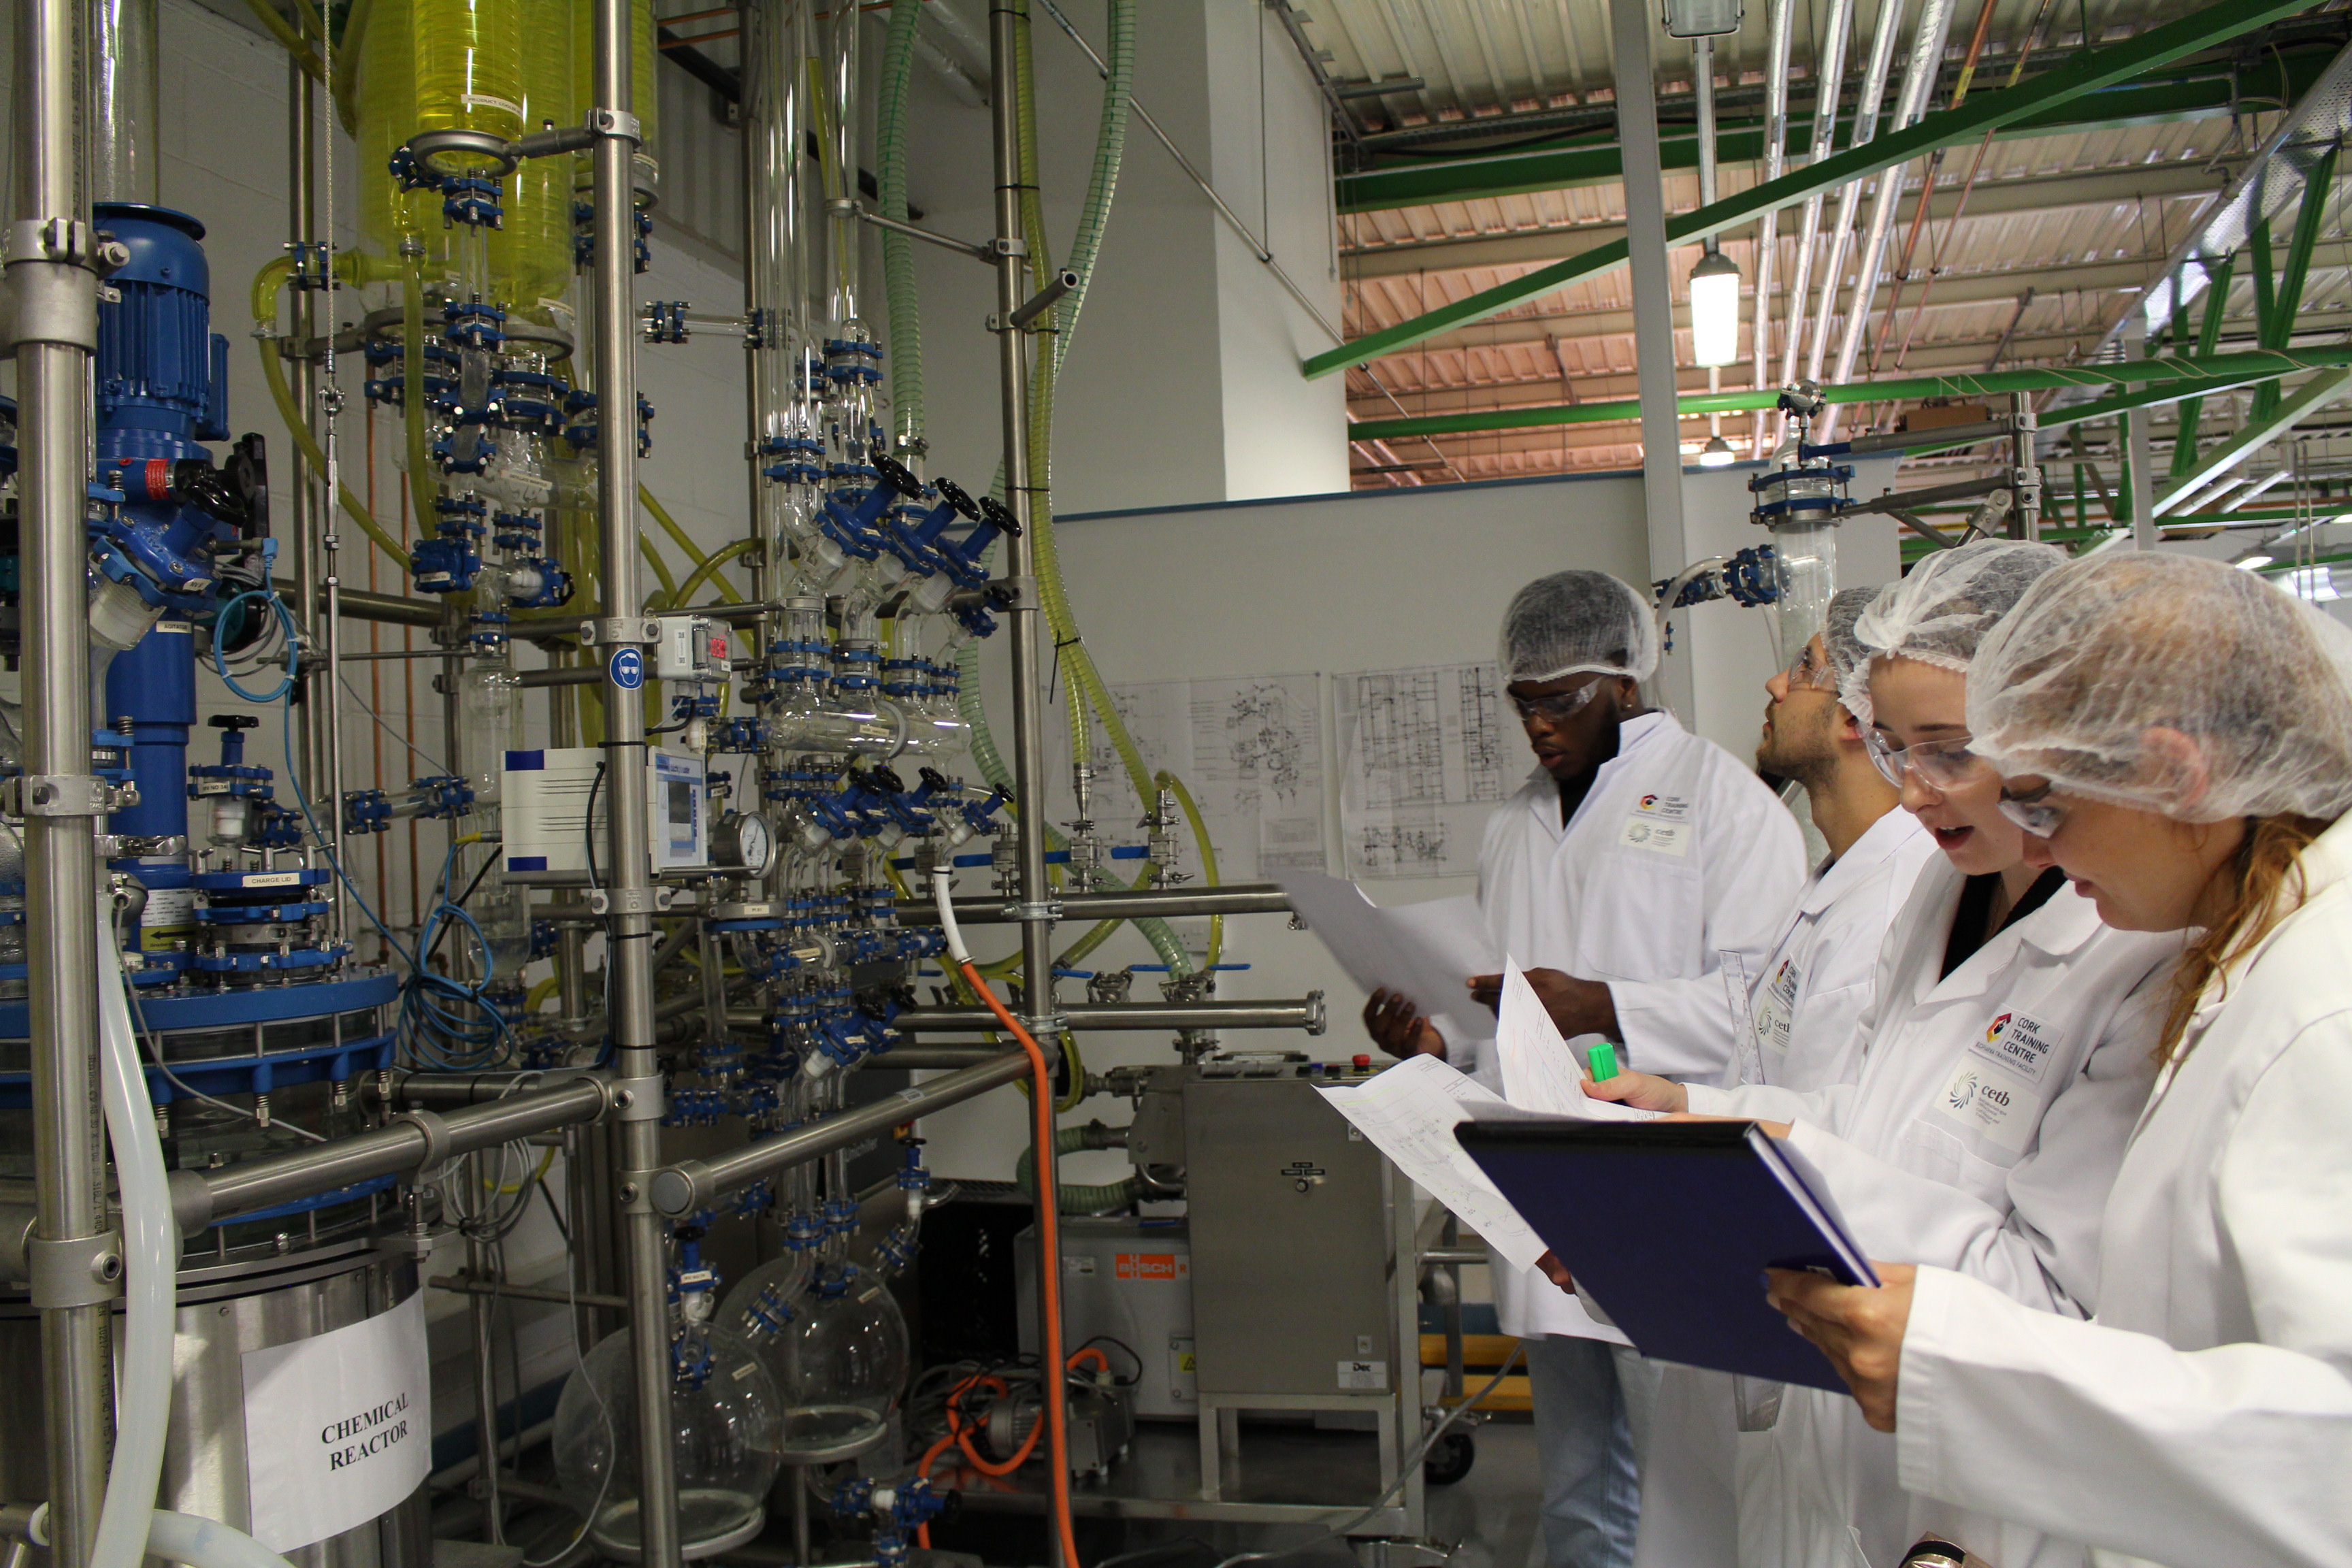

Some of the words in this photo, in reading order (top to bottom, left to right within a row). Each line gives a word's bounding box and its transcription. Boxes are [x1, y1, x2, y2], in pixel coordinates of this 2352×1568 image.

[2017, 1017, 2041, 1034] CORK
[2004, 1041, 2037, 1063] CENTRE
[2011, 1028, 2050, 1054] TRAINING
[1995, 1050, 2016, 1066] TRAINING
[2016, 1060, 2037, 1075] FACILITY
[1980, 1085, 2010, 1107] cetb
[99, 1305, 108, 1317] EN
[100, 1325, 109, 1358] 10217-7
[321, 1392, 408, 1444] CHEMICAL
[329, 1419, 408, 1471] REACTOR
